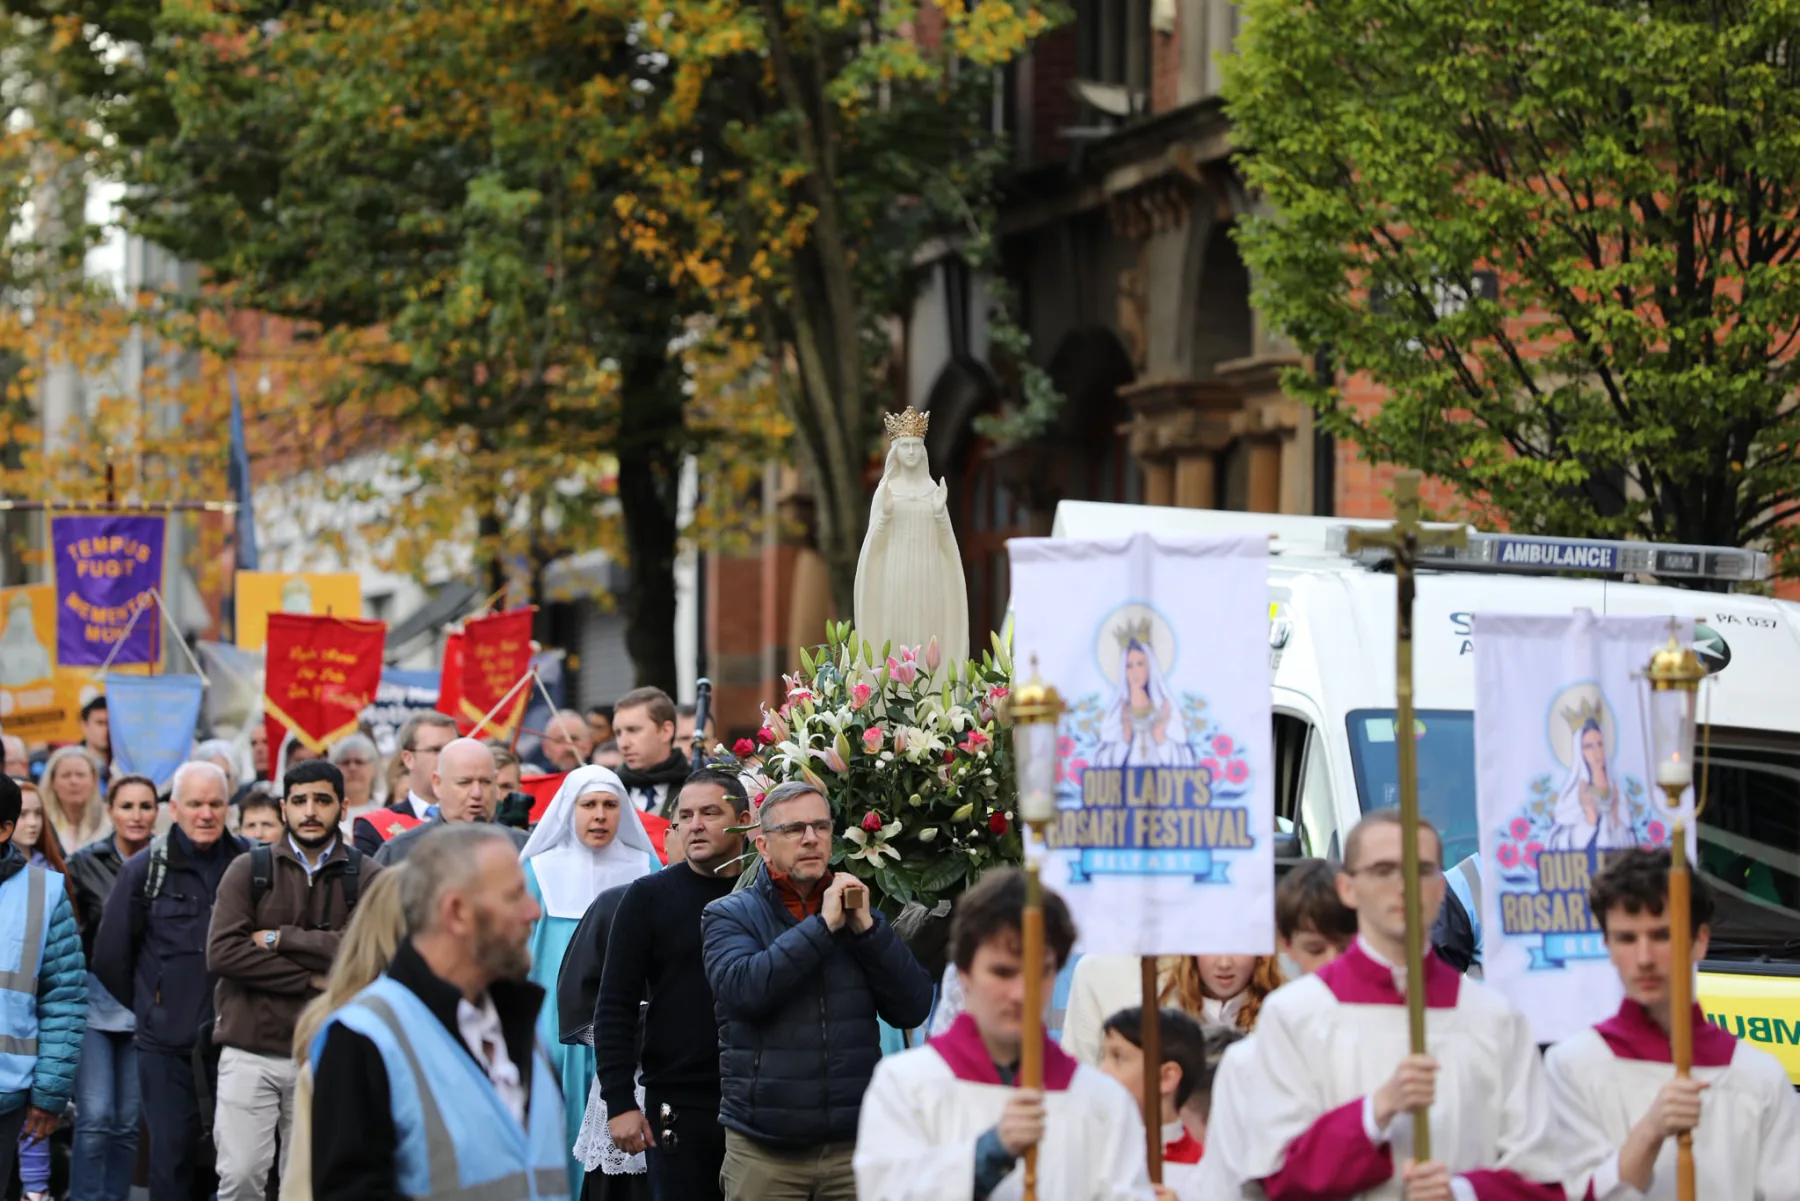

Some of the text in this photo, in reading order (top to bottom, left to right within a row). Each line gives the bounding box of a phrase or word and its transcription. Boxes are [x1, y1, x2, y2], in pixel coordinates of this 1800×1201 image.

[67, 535, 152, 563] TEMPUS
[1502, 542, 1611, 568] AMBULANCE
[77, 558, 136, 579] FUGT
[1715, 612, 1743, 625] PA
[1083, 768, 1211, 807] OUR LADY'S
[1048, 808, 1253, 848] ROSARY FESTIVAL
[1538, 851, 1592, 891] OUR
